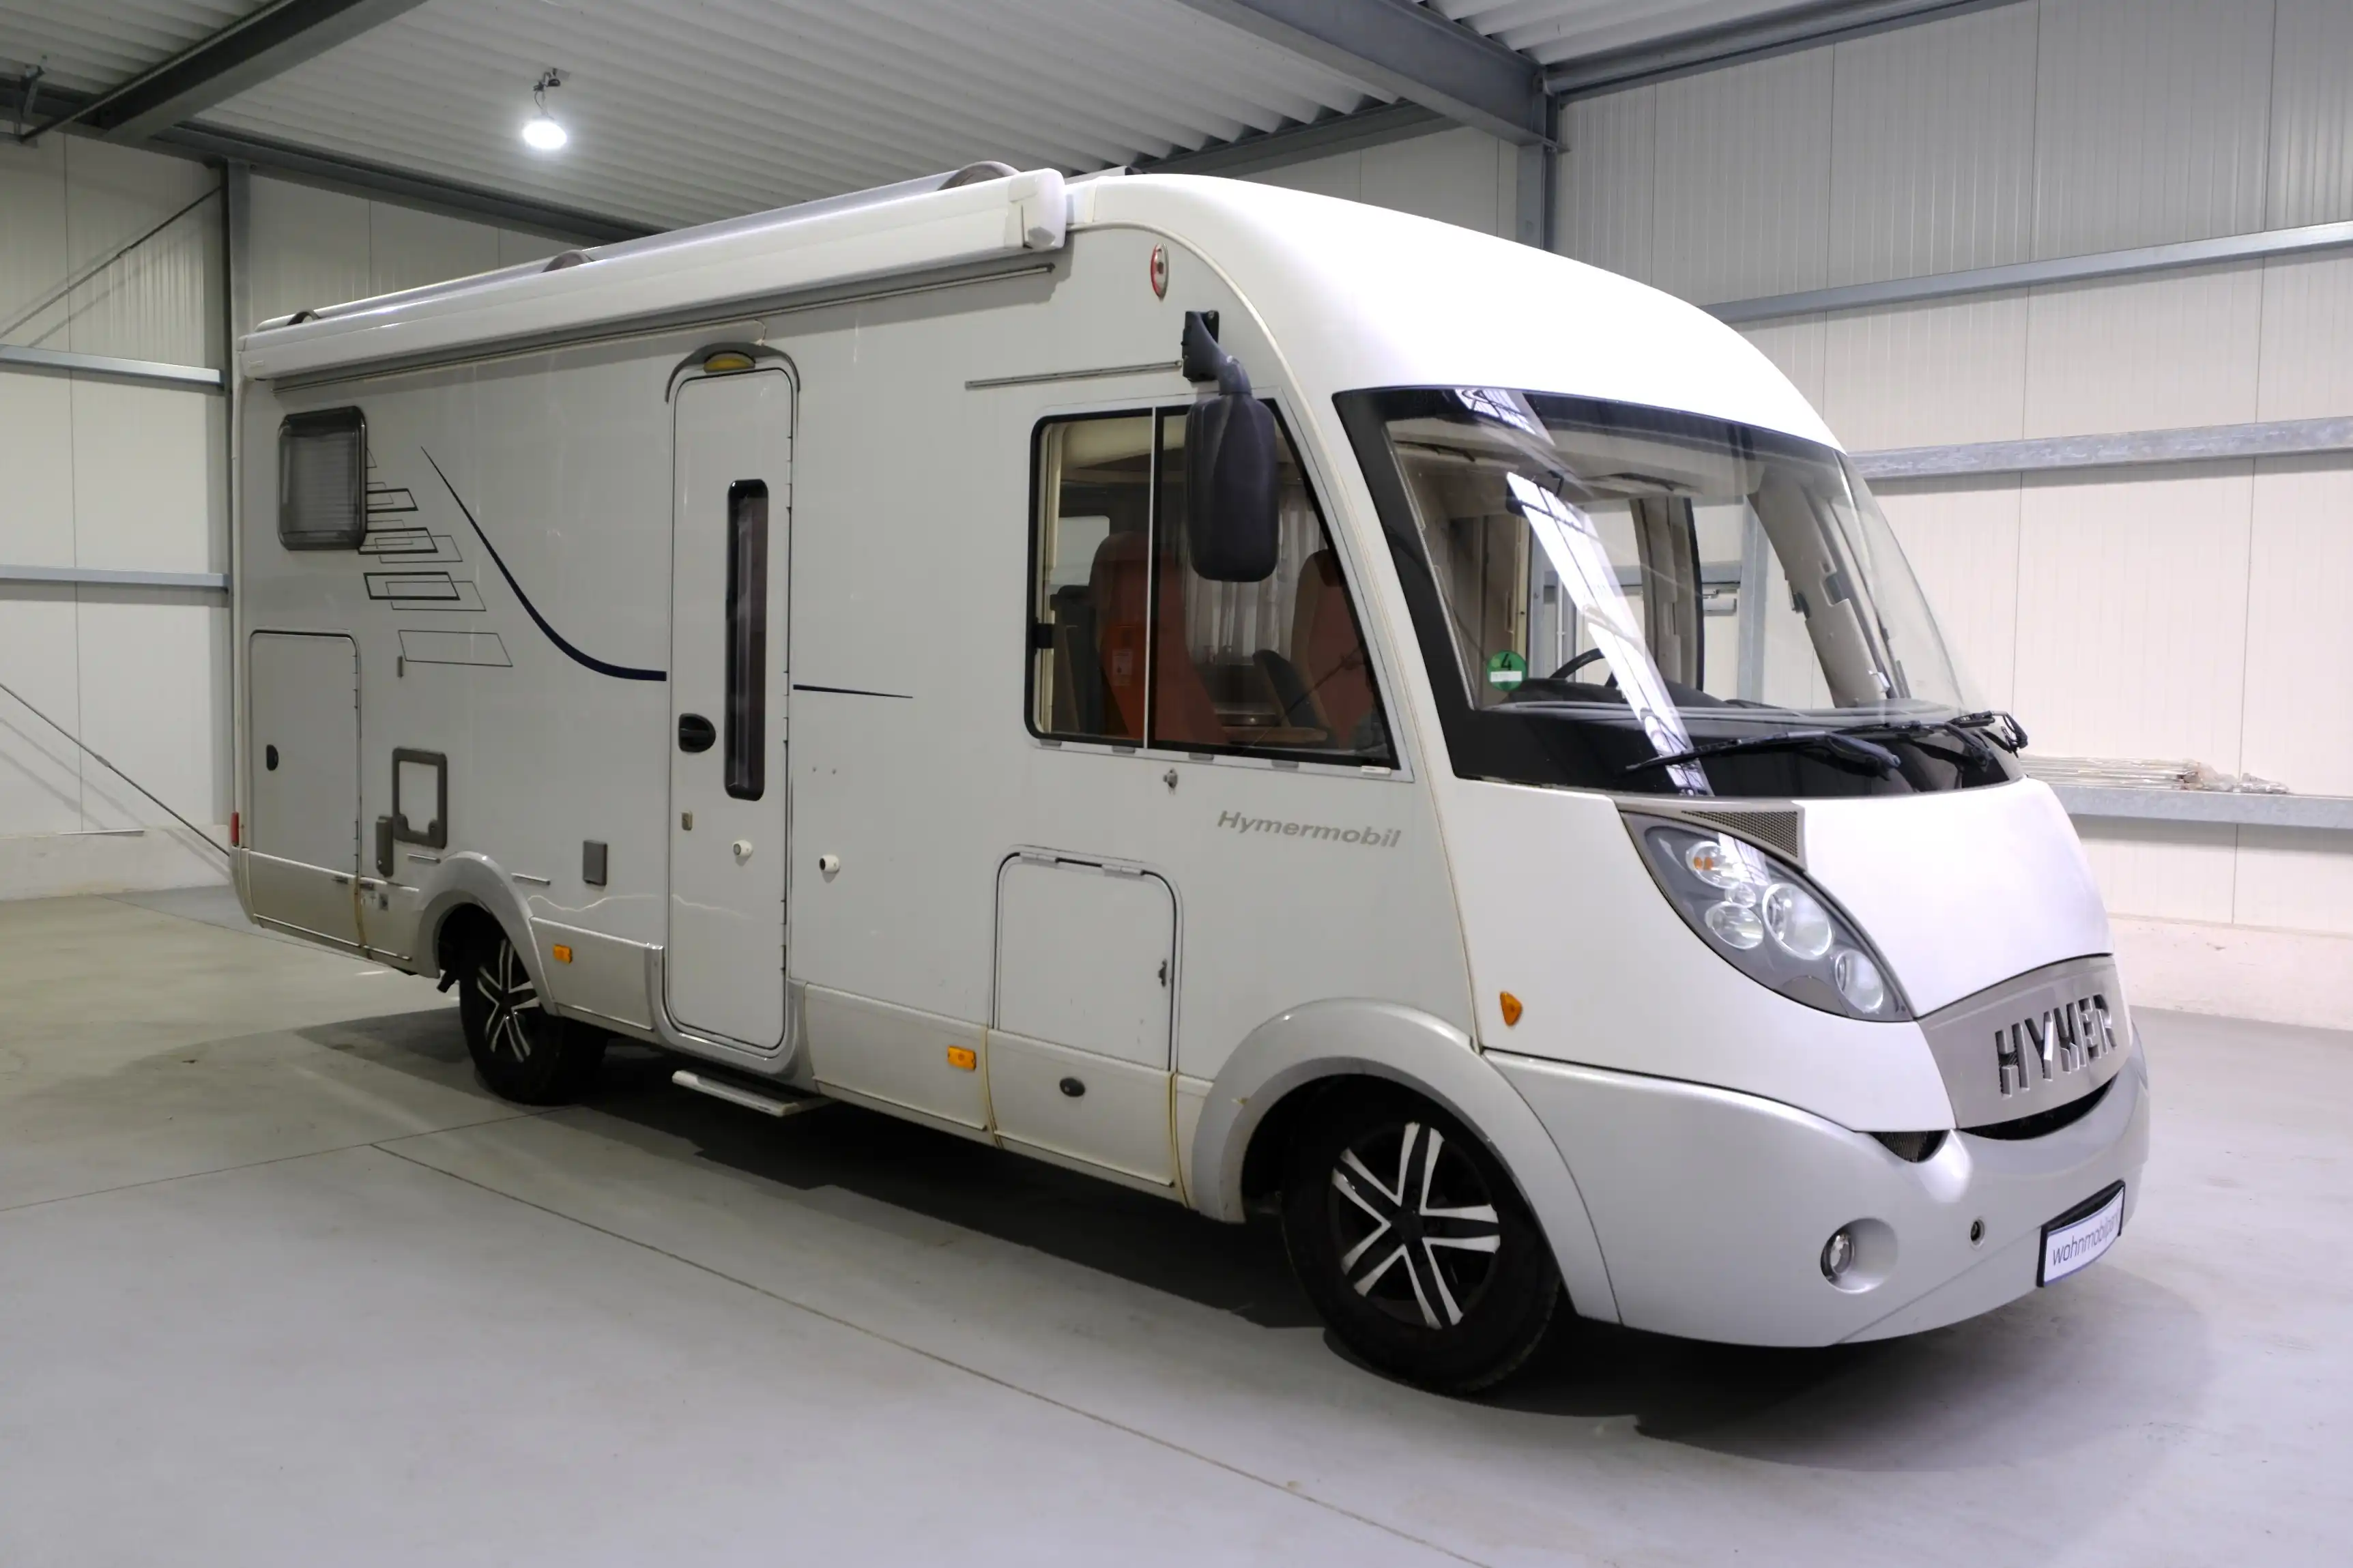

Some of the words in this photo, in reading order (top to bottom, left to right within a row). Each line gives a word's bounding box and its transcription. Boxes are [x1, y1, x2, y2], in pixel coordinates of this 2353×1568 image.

[1501, 652, 1512, 671] 4
[1217, 810, 1402, 847] Hymermobil
[1995, 993, 2118, 1099] HYMER
